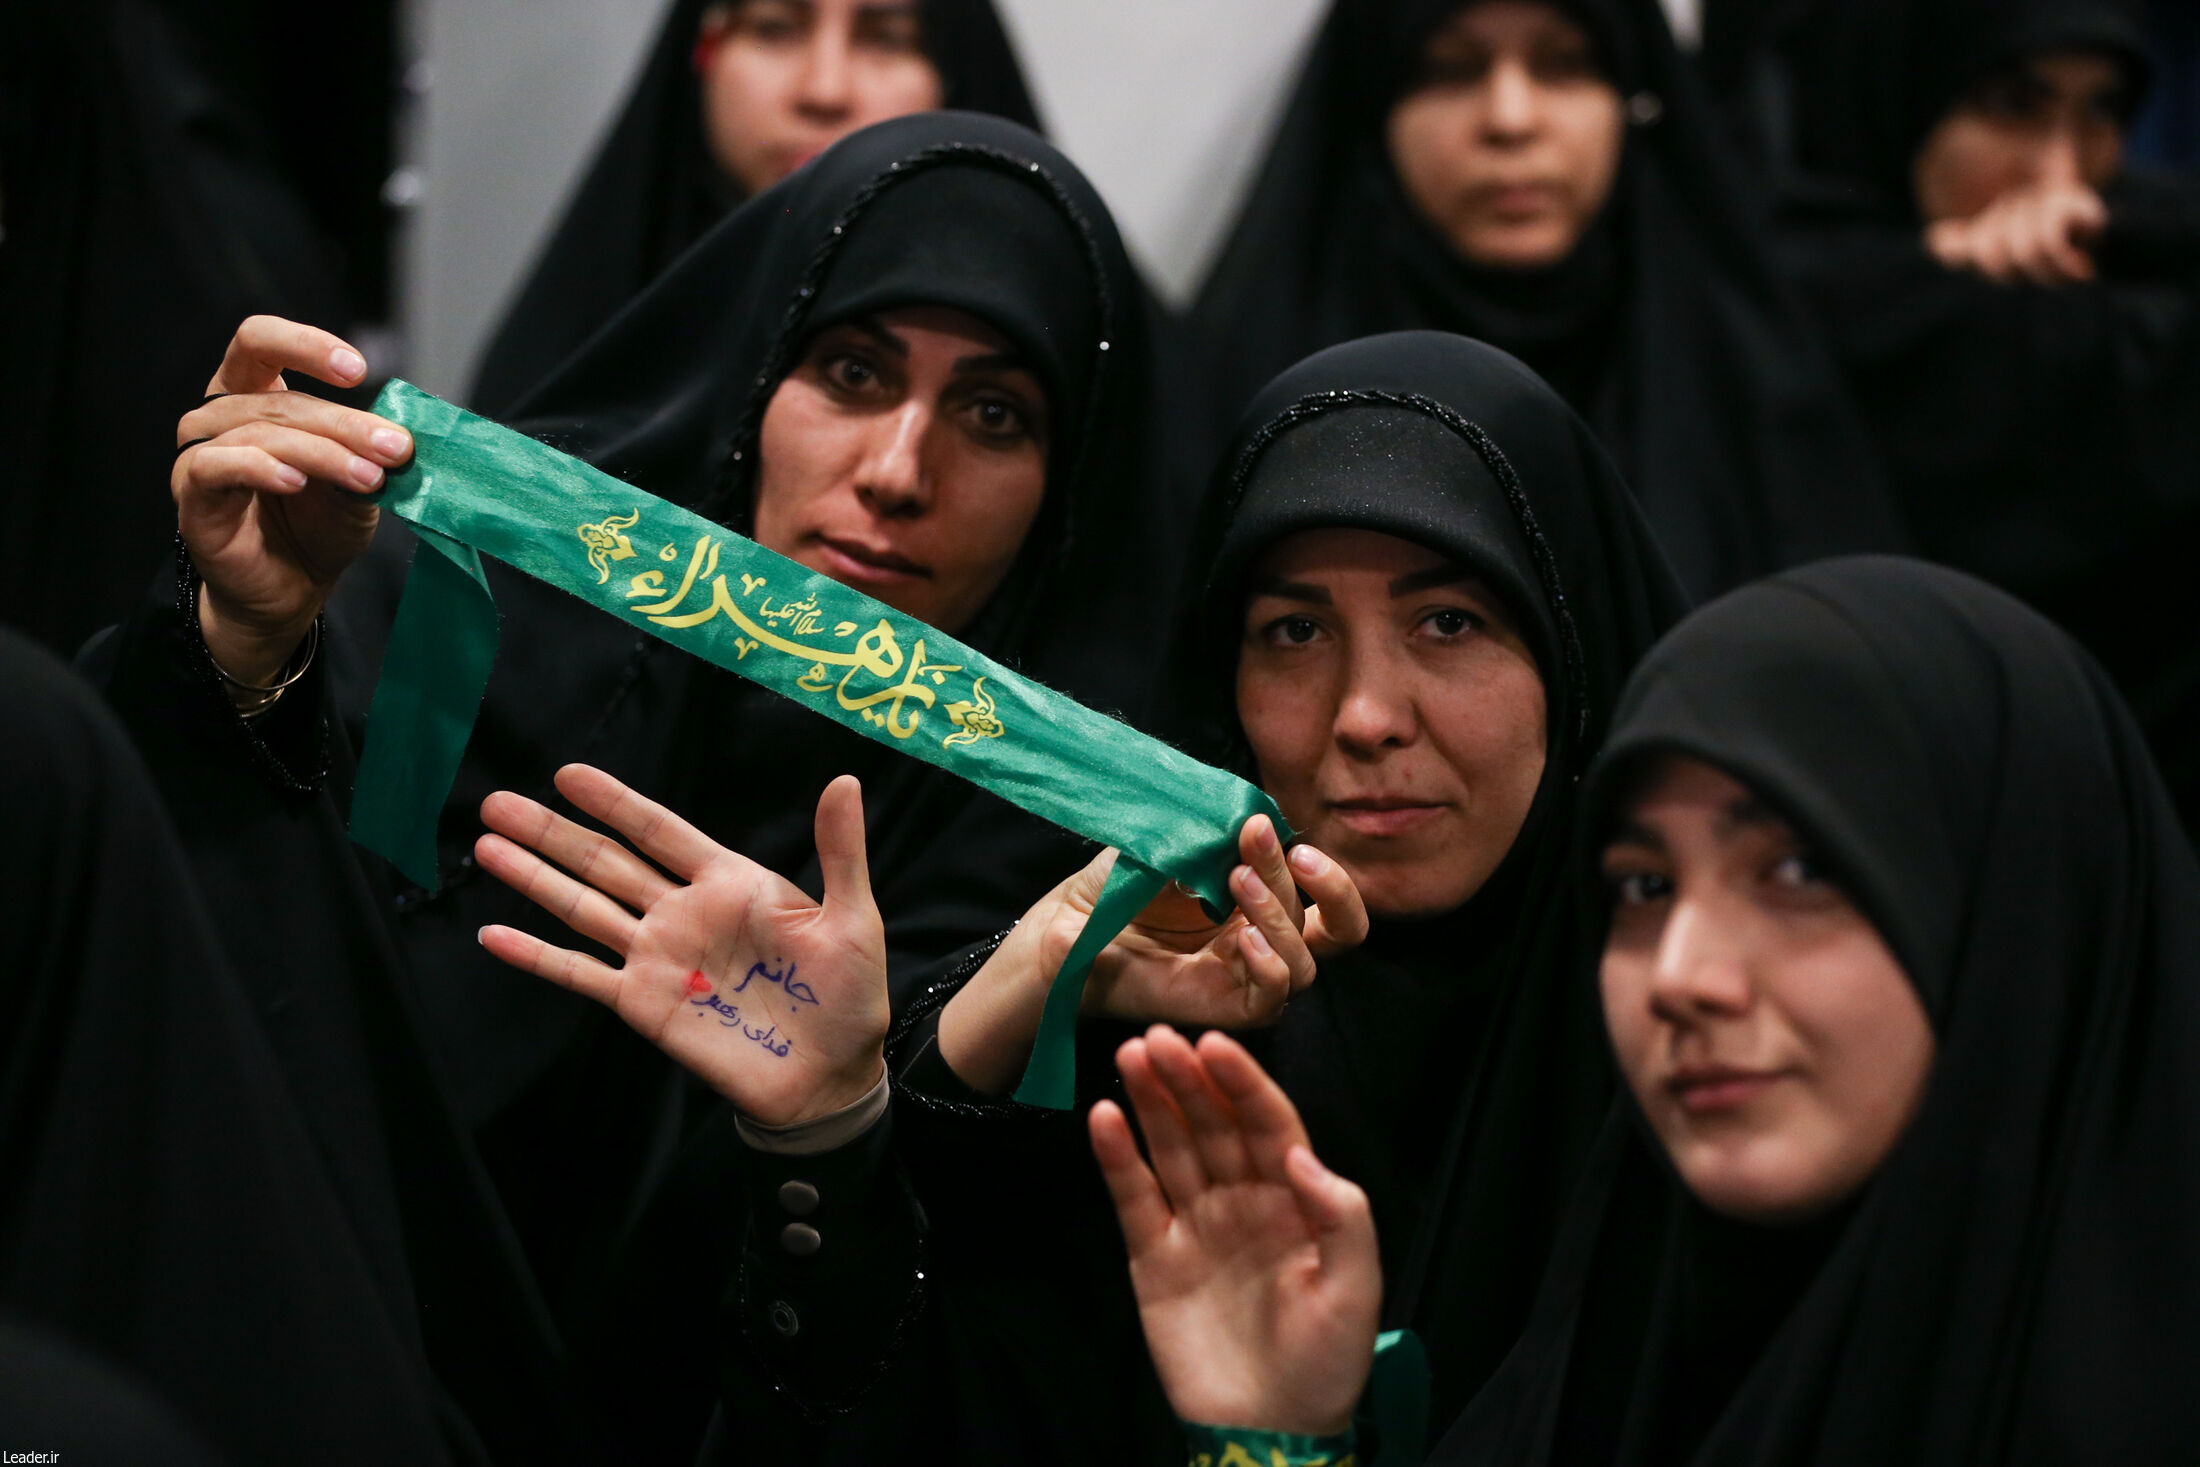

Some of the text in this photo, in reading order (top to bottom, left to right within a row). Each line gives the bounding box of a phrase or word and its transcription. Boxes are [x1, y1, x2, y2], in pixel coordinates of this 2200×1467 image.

[733, 957, 820, 1012] جانم
[690, 993, 792, 1057] فدای رهبر
